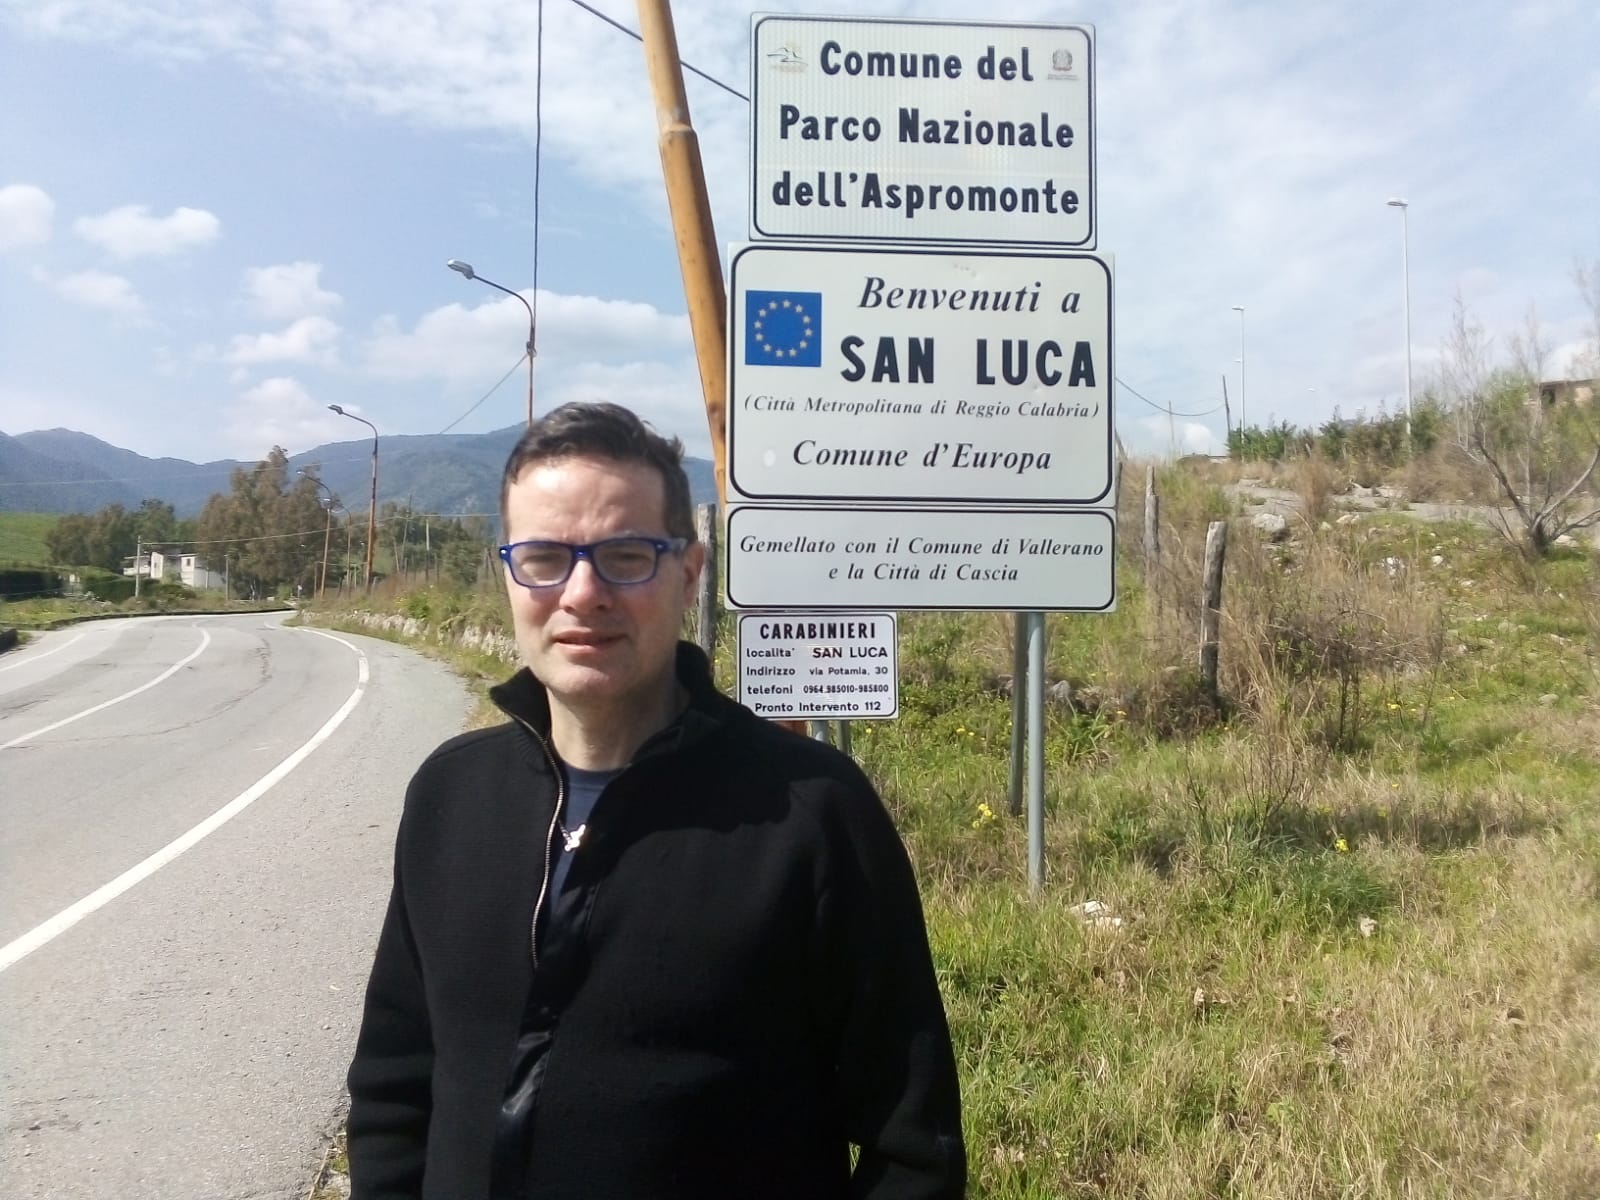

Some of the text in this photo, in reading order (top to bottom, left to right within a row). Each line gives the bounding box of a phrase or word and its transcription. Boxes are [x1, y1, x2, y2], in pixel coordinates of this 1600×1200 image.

[820, 40, 1034, 81] Comune del
[780, 104, 1074, 148] Parco Nazionale
[772, 171, 1079, 218] dell'Aspromonte
[858, 277, 1081, 313] Benvenuti a
[840, 335, 1096, 387] SAN LUCA
[745, 395, 1099, 418] (Città Metropolitana di Reggio Calabria)
[794, 440, 1051, 474] Comune d'Europa
[740, 536, 1103, 555] Gemellato con il Comune di Vallerano
[829, 563, 1019, 581] e la Città di Cascia
[760, 623, 875, 639] CARABINIERI
[812, 647, 842, 658] SAN
[850, 647, 888, 658] LUCA
[747, 685, 792, 694] telefoni
[755, 701, 881, 712] Pronto Intervento 112
